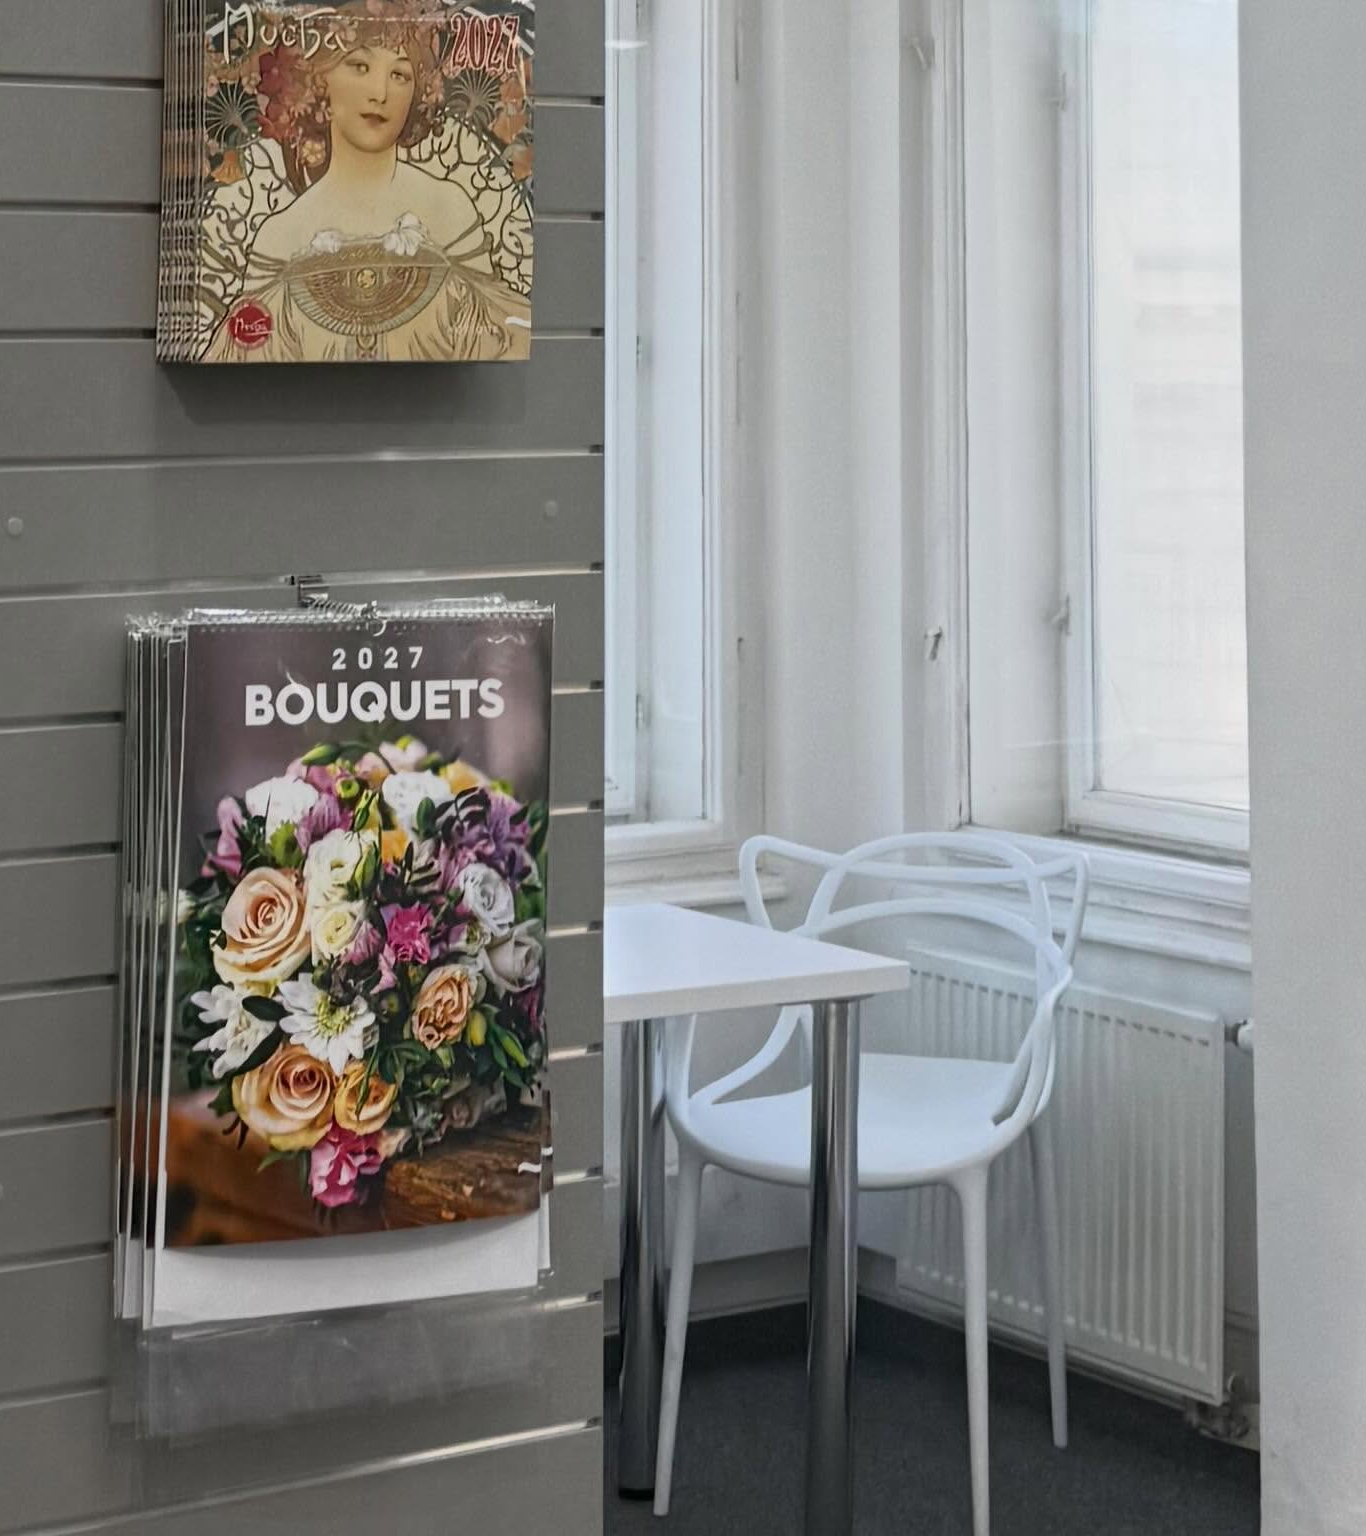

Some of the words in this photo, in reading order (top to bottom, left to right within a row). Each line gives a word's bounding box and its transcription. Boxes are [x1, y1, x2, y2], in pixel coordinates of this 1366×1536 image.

[450, 13, 520, 72] 2027
[332, 646, 423, 670] 2027
[245, 678, 505, 726] BOUQUETS
